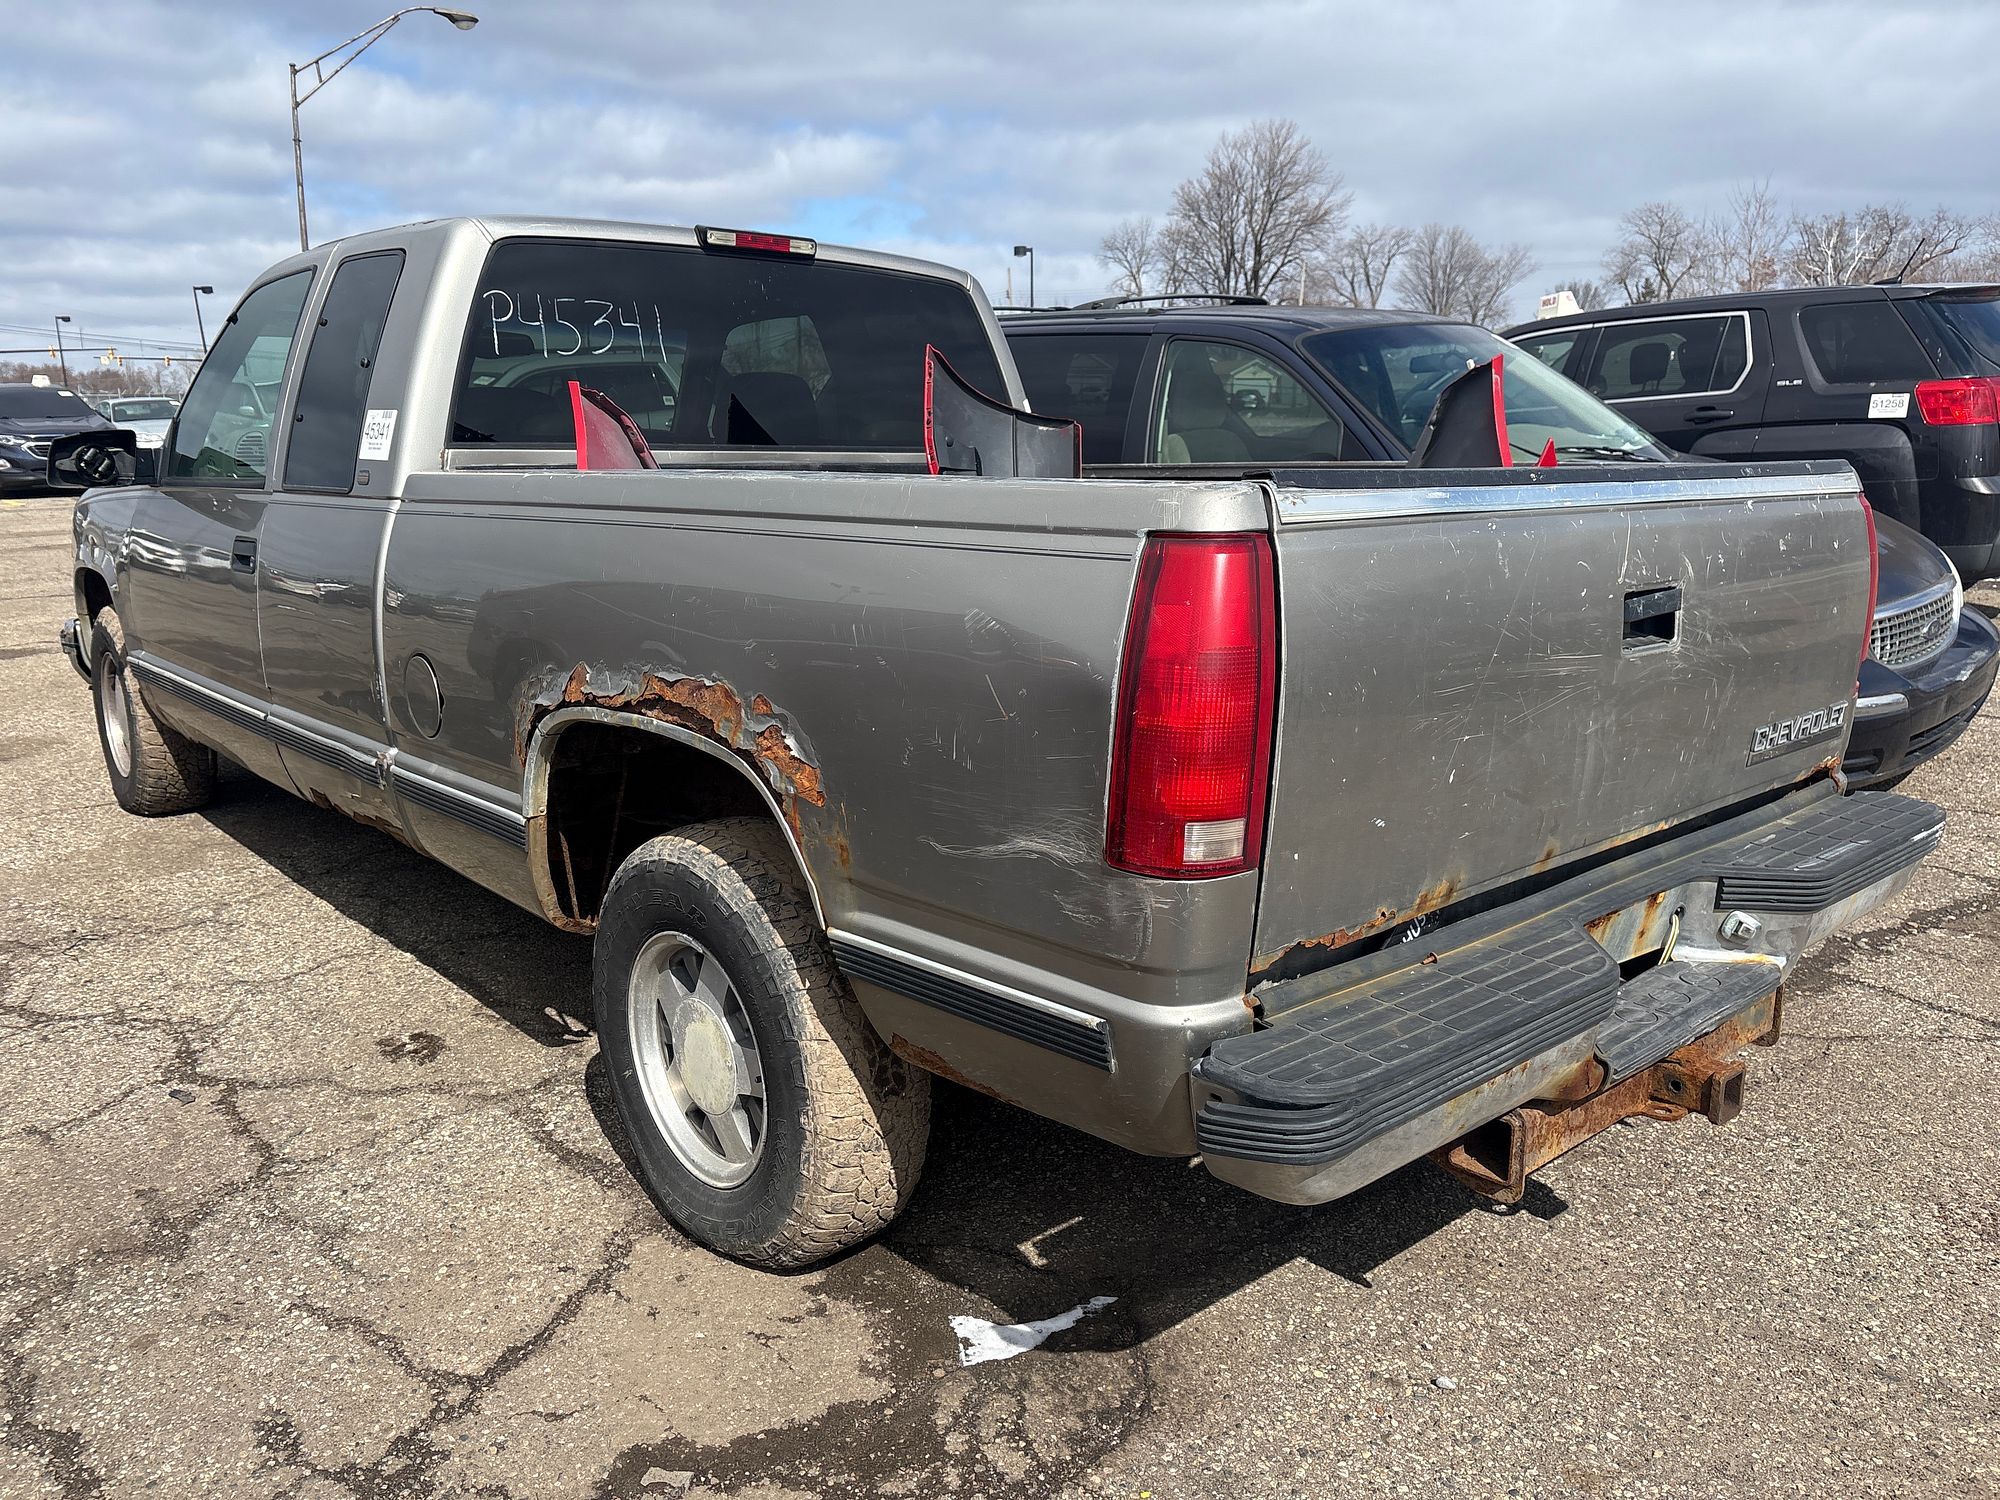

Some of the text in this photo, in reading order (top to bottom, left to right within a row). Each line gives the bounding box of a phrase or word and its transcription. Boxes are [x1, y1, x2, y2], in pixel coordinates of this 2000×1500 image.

[483, 289, 667, 363] P45341
[1871, 399, 1905, 409] 51258
[364, 422, 391, 441] 45341
[1751, 700, 1848, 753] CHEVROLET
